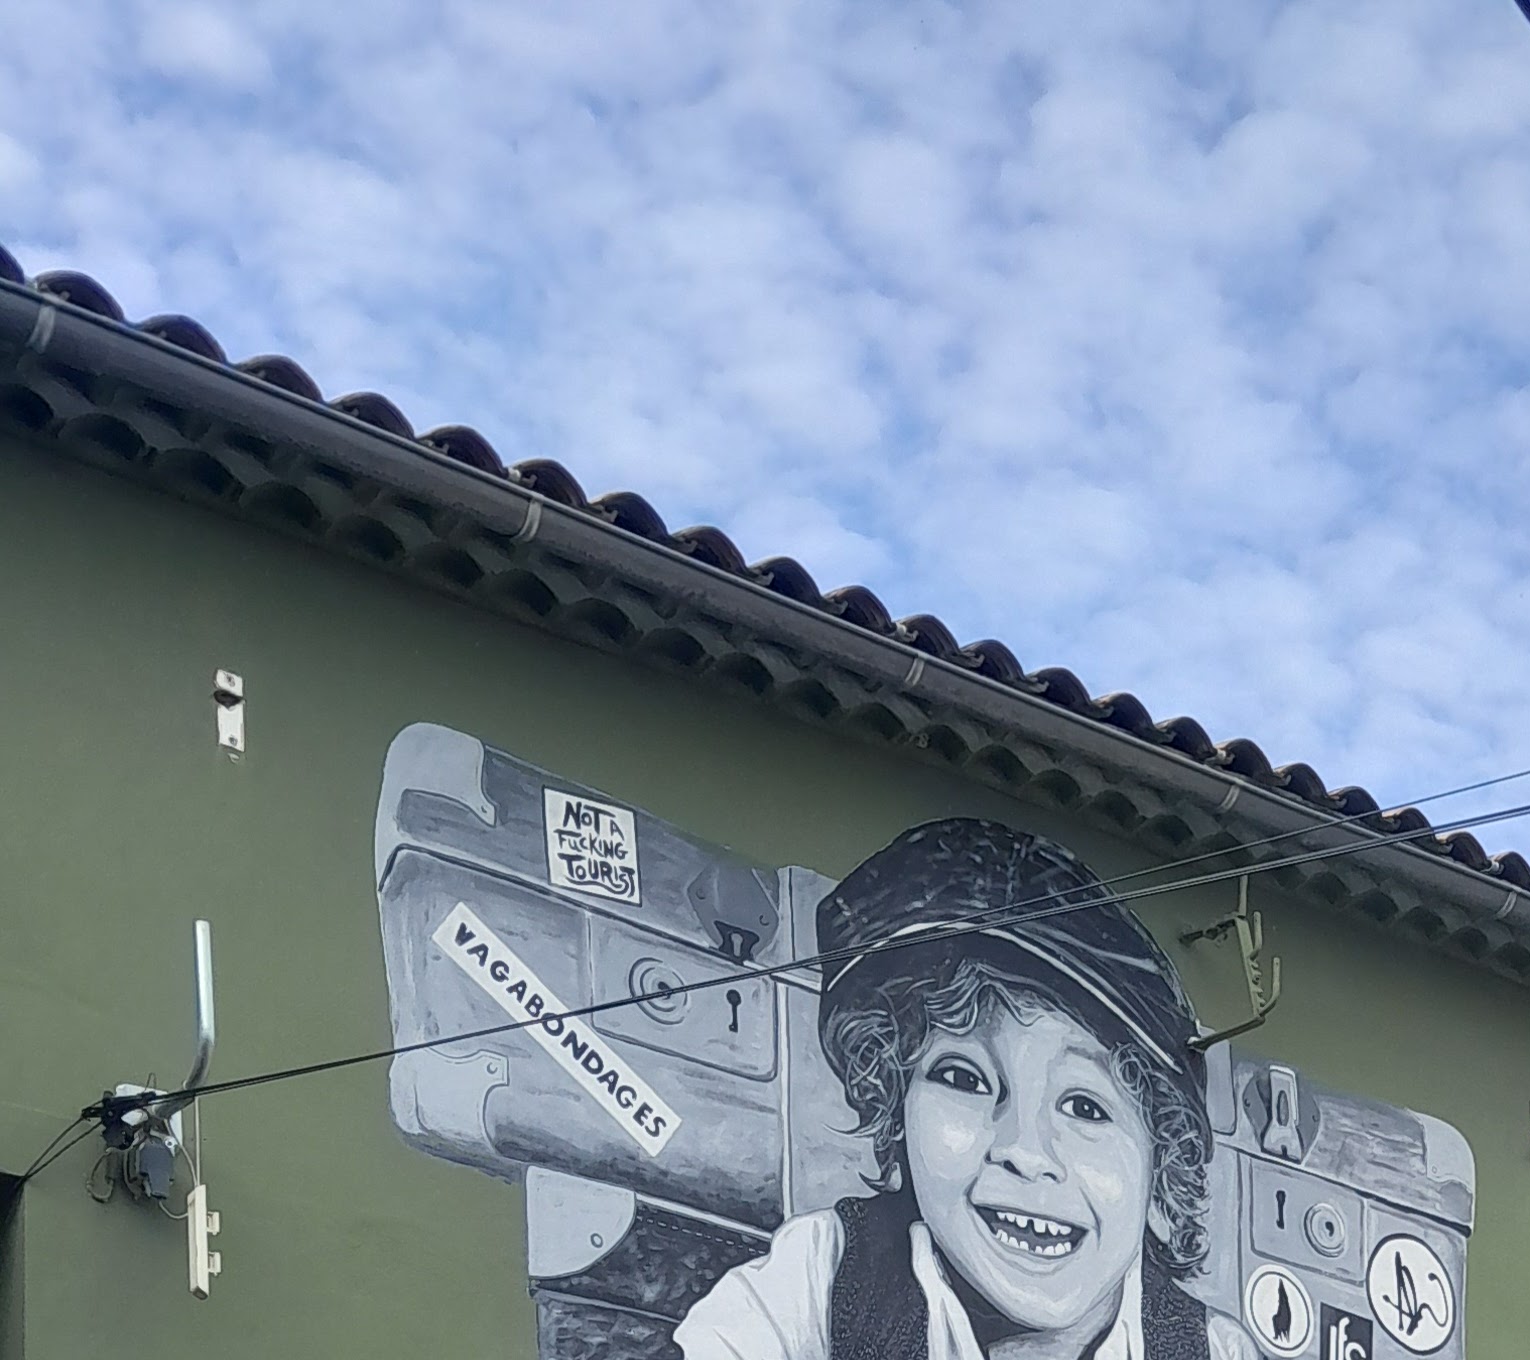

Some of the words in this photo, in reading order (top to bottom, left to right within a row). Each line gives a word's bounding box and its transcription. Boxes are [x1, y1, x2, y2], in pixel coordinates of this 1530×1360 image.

[563, 801, 616, 834] NOT
[610, 819, 625, 841] A
[553, 828, 629, 860] FUCKING
[557, 853, 635, 898] TOURIST
[453, 923, 667, 1138] VAGABONDAGES
